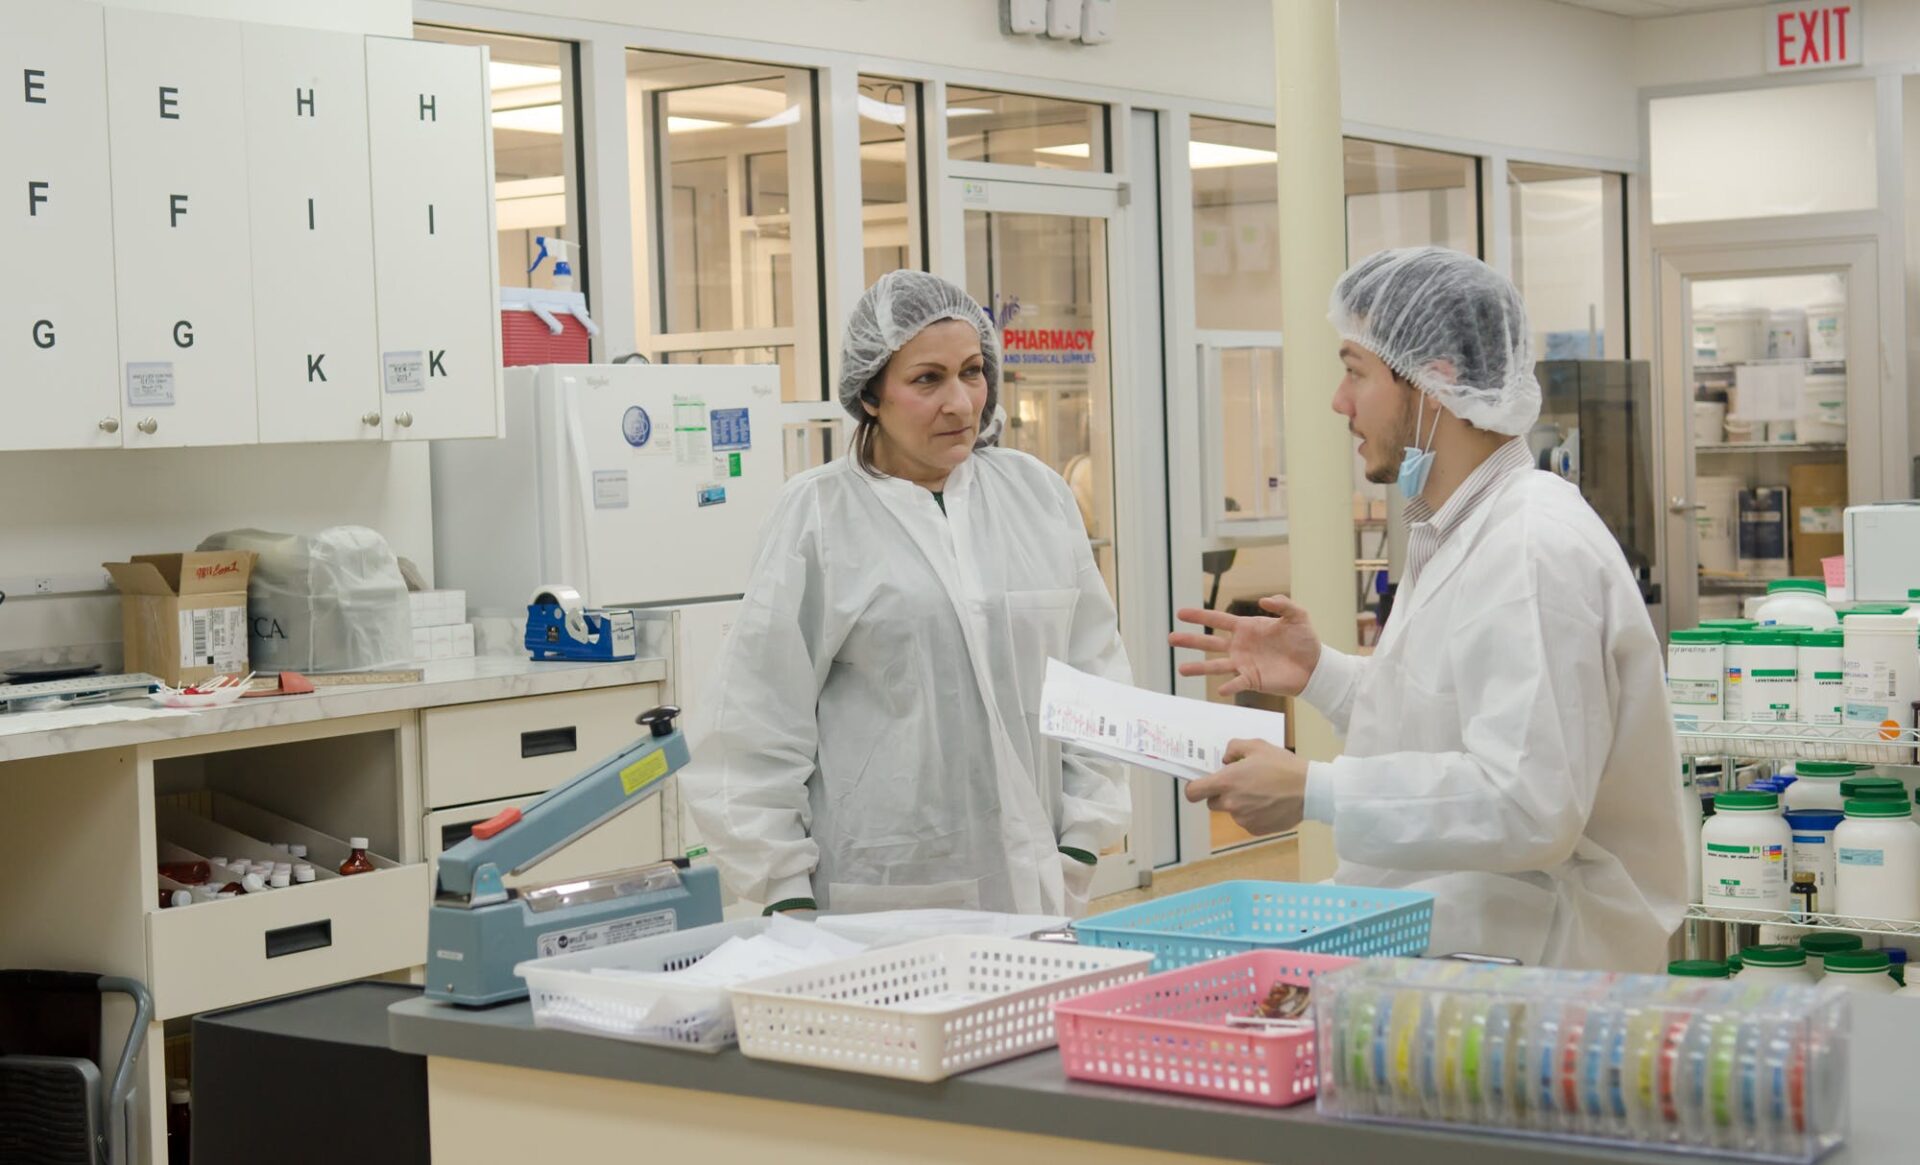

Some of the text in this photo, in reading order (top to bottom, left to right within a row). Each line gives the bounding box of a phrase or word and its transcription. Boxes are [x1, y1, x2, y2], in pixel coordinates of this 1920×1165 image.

[1777, 6, 1851, 66] EXIT
[24, 69, 46, 104] E
[158, 86, 179, 120] E
[296, 87, 315, 117] H
[419, 93, 436, 122] H
[28, 181, 49, 216] F
[169, 194, 188, 228] F
[308, 198, 315, 230] I
[428, 204, 434, 235] I
[32, 319, 55, 349] G
[173, 320, 194, 348] G
[1003, 330, 1095, 350] PHARMACY
[307, 354, 327, 382] K
[429, 350, 447, 377] K
[1003, 353, 1096, 364] AND SURGICAL SUPPLIES
[250, 616, 287, 639] CA
